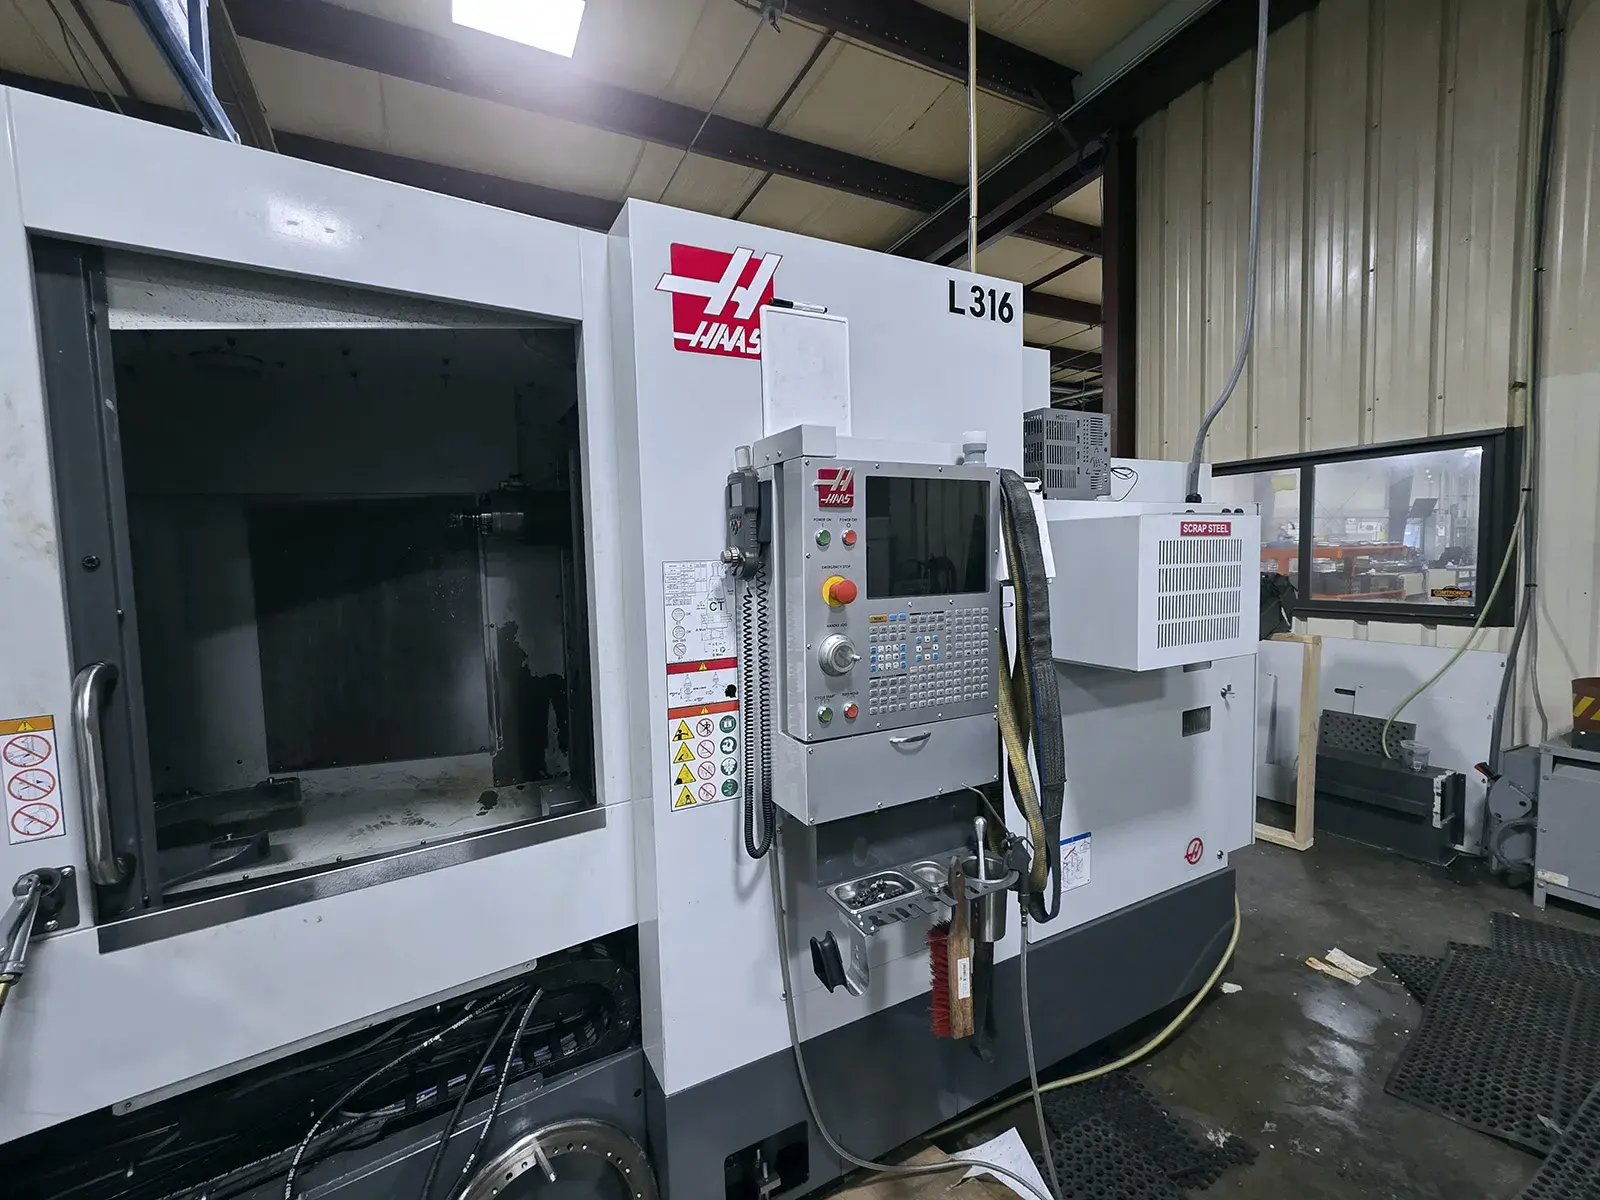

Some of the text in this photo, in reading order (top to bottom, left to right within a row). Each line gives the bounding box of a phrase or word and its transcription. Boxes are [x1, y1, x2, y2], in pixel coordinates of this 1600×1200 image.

[948, 279, 1014, 324] L316
[673, 321, 762, 354] HAAS
[820, 493, 855, 504] HAAS
[1183, 523, 1229, 533] SCRAP STEEL
[709, 601, 724, 612] CT
